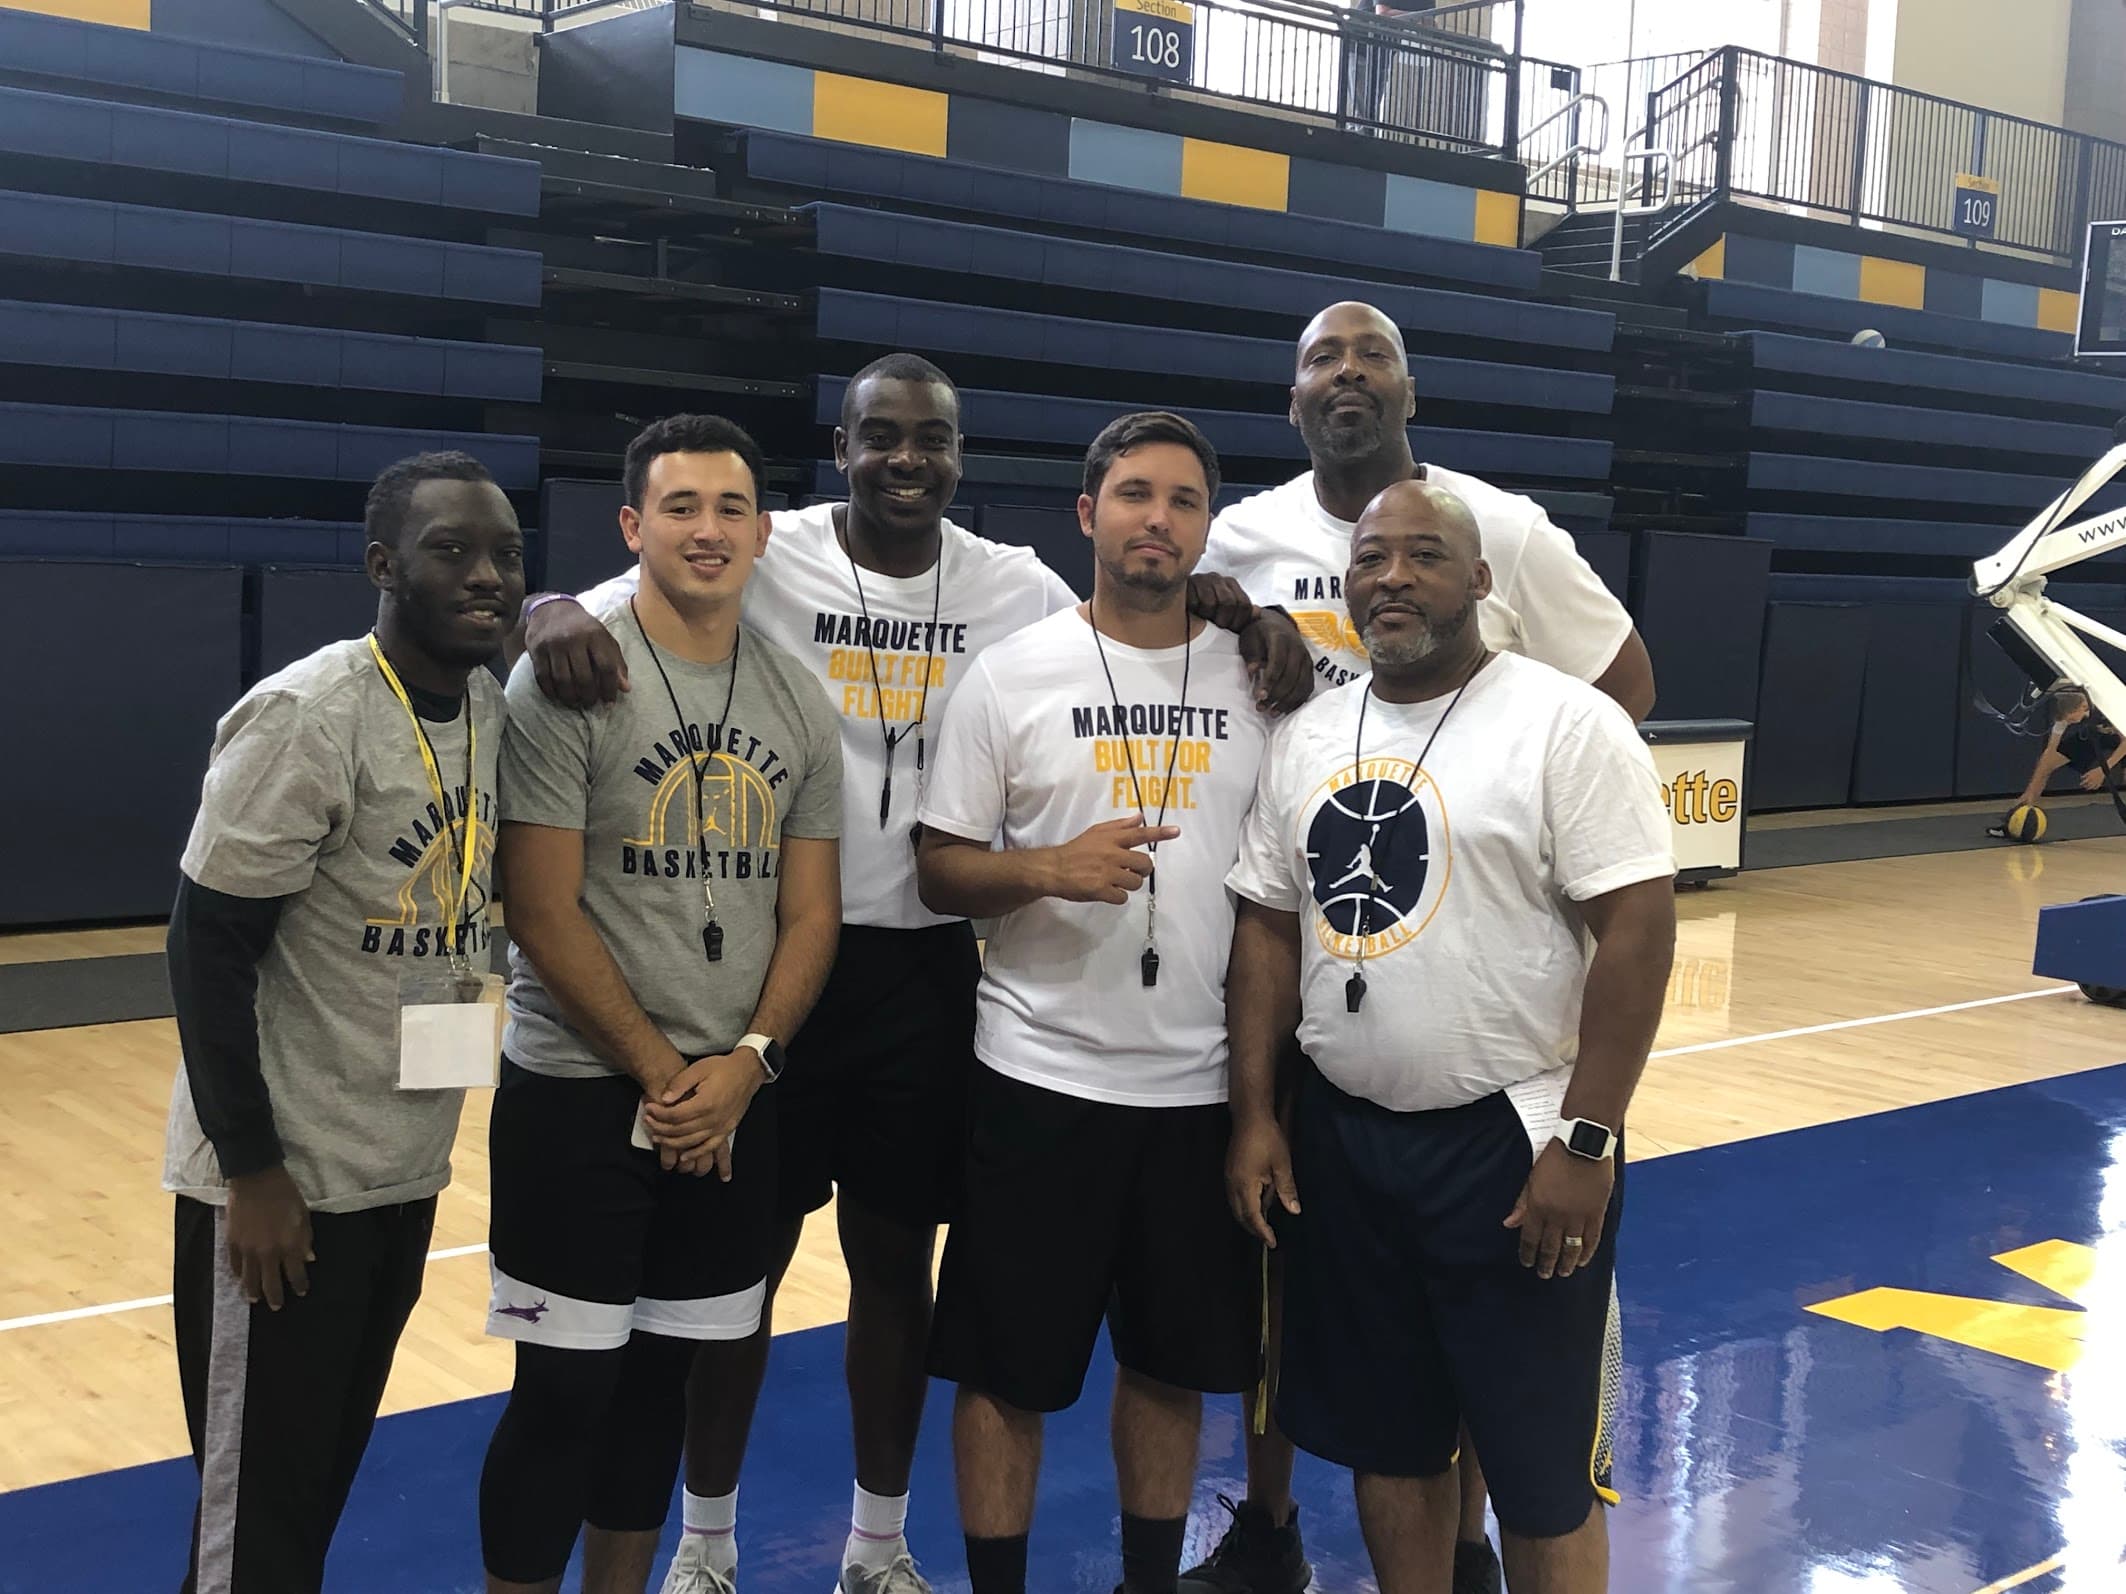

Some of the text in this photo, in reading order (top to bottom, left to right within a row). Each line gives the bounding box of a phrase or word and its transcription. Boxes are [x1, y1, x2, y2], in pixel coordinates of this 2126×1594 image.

[1136, 0, 1177, 18] Section
[1131, 25, 1180, 68] 108
[1963, 198, 1991, 227] 109
[1294, 576, 1342, 600] MAR
[814, 613, 967, 654] MARQUETTE
[828, 648, 947, 688] BUILT FOR
[1072, 704, 1229, 740] MARQUETTE
[633, 723, 788, 790] MARQUETTE
[1094, 740, 1211, 773] BUILT FOR
